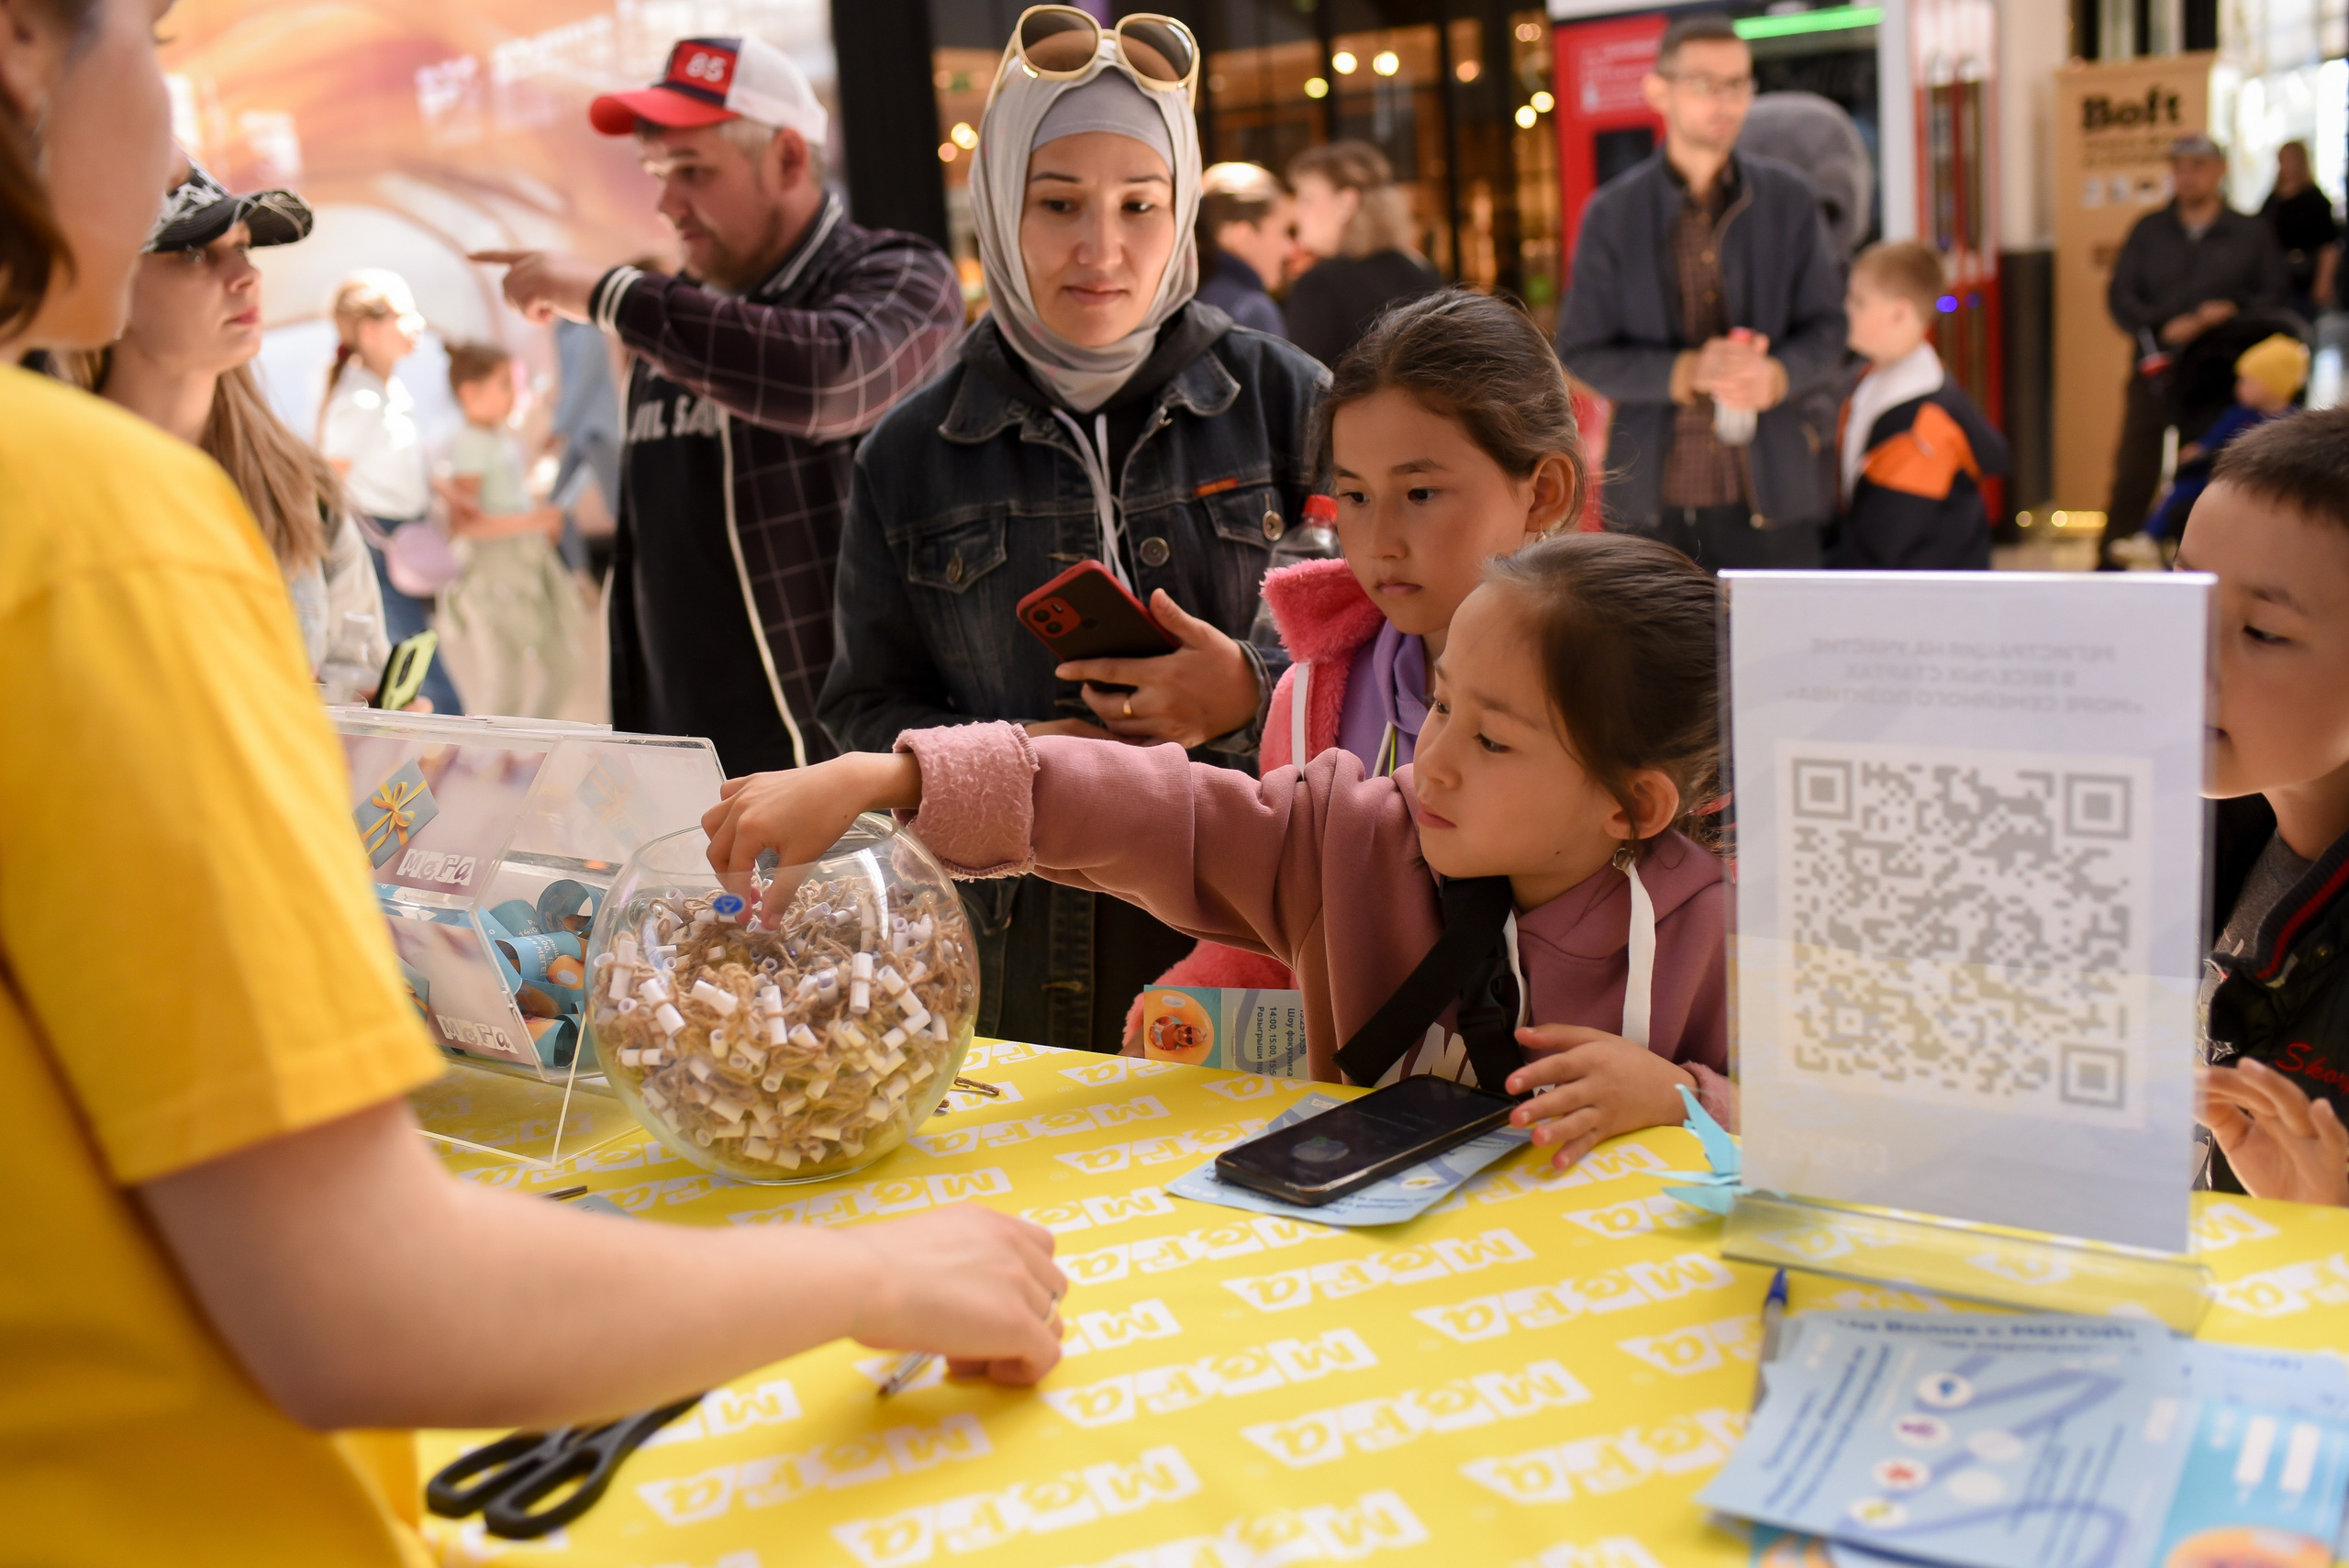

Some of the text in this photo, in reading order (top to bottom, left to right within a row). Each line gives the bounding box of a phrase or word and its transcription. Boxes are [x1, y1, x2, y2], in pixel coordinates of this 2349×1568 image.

[1255, 1006, 1265, 1060] Розыгрыши
[1267, 1006, 1277, 1075] 14:00, 15:00, 15:5
[1285, 1007, 1296, 1077] Шоу фокусника
